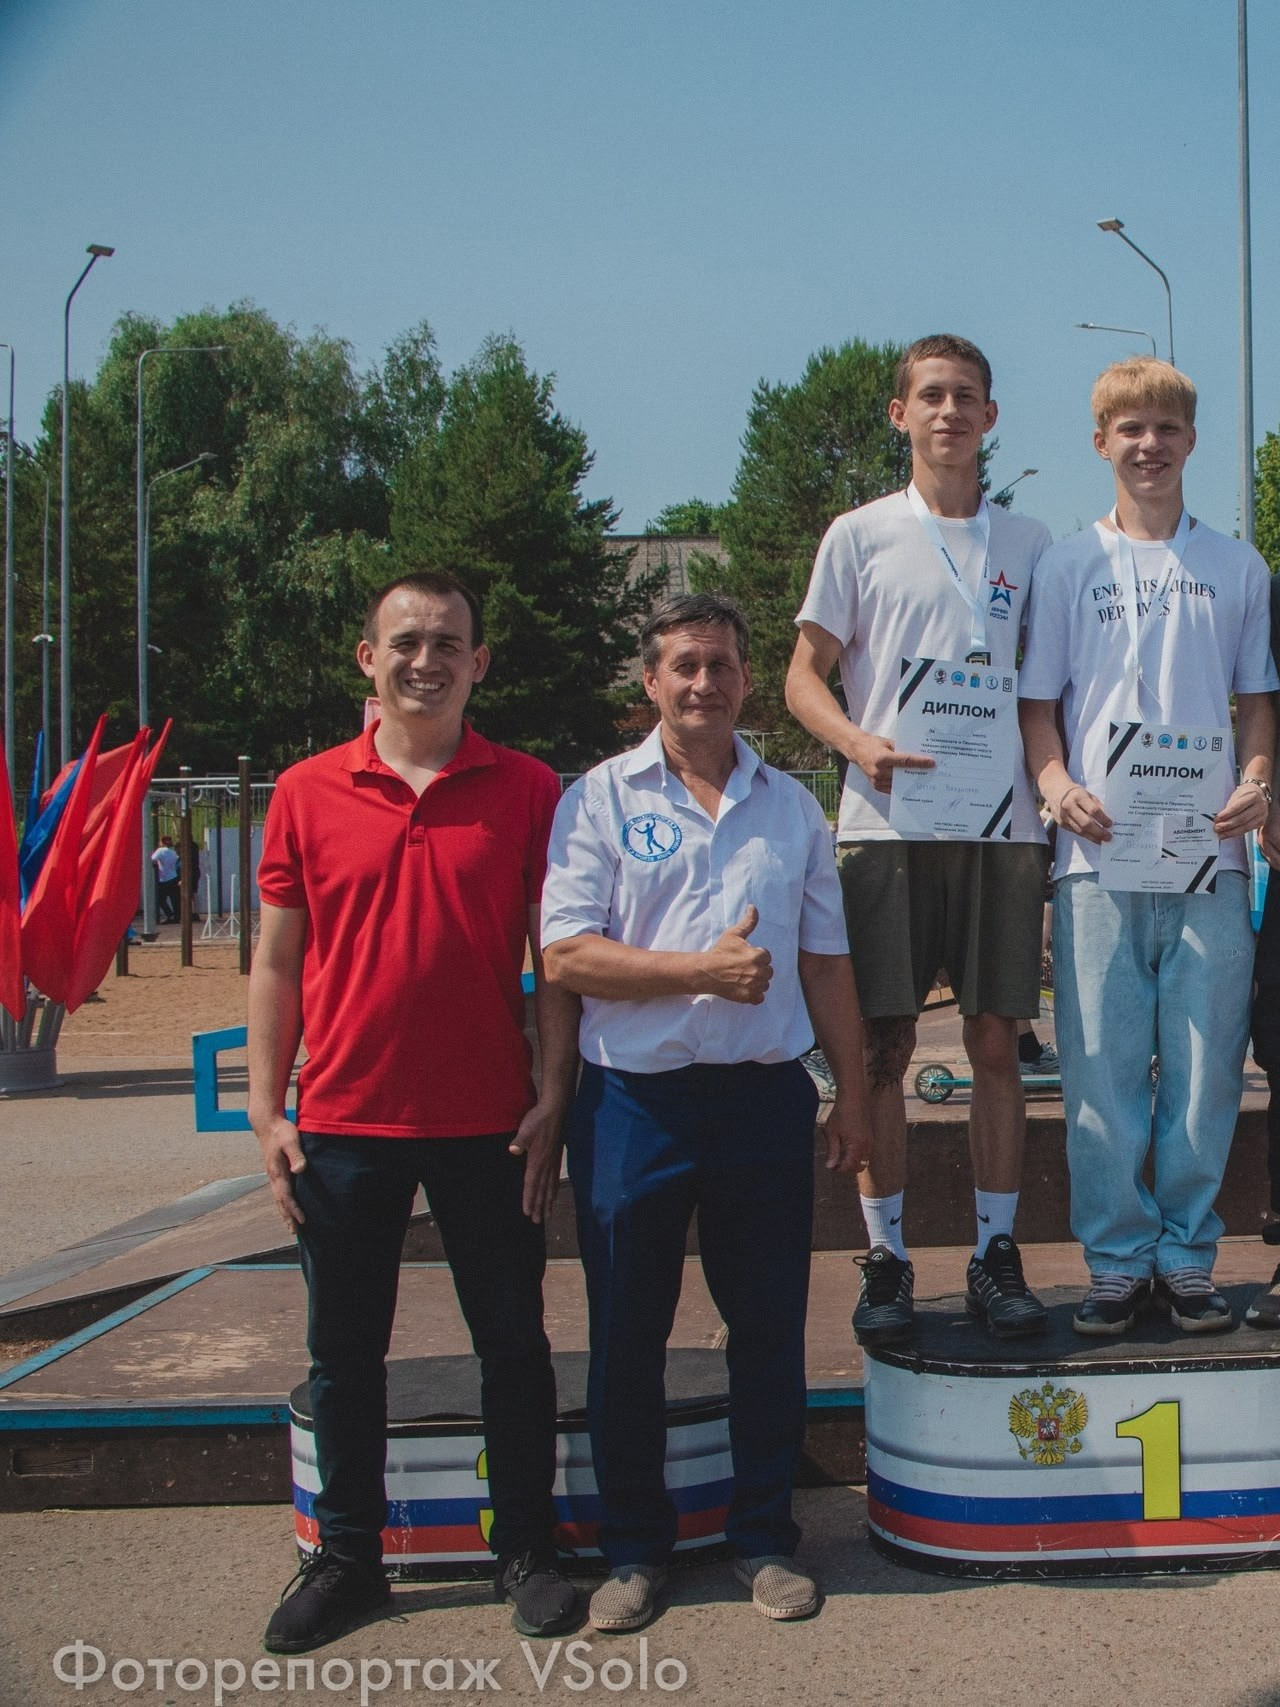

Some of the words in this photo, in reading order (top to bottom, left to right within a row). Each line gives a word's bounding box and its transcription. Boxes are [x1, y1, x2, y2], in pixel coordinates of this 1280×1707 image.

[1092, 579, 1158, 601] ENFNTS
[1170, 580, 1216, 599] ICHES
[1098, 600, 1170, 623] DÉPIMS
[922, 701, 996, 719] ДИПЛОМ
[1129, 764, 1204, 779] ДИПЛОМ
[1115, 1400, 1182, 1521] 1
